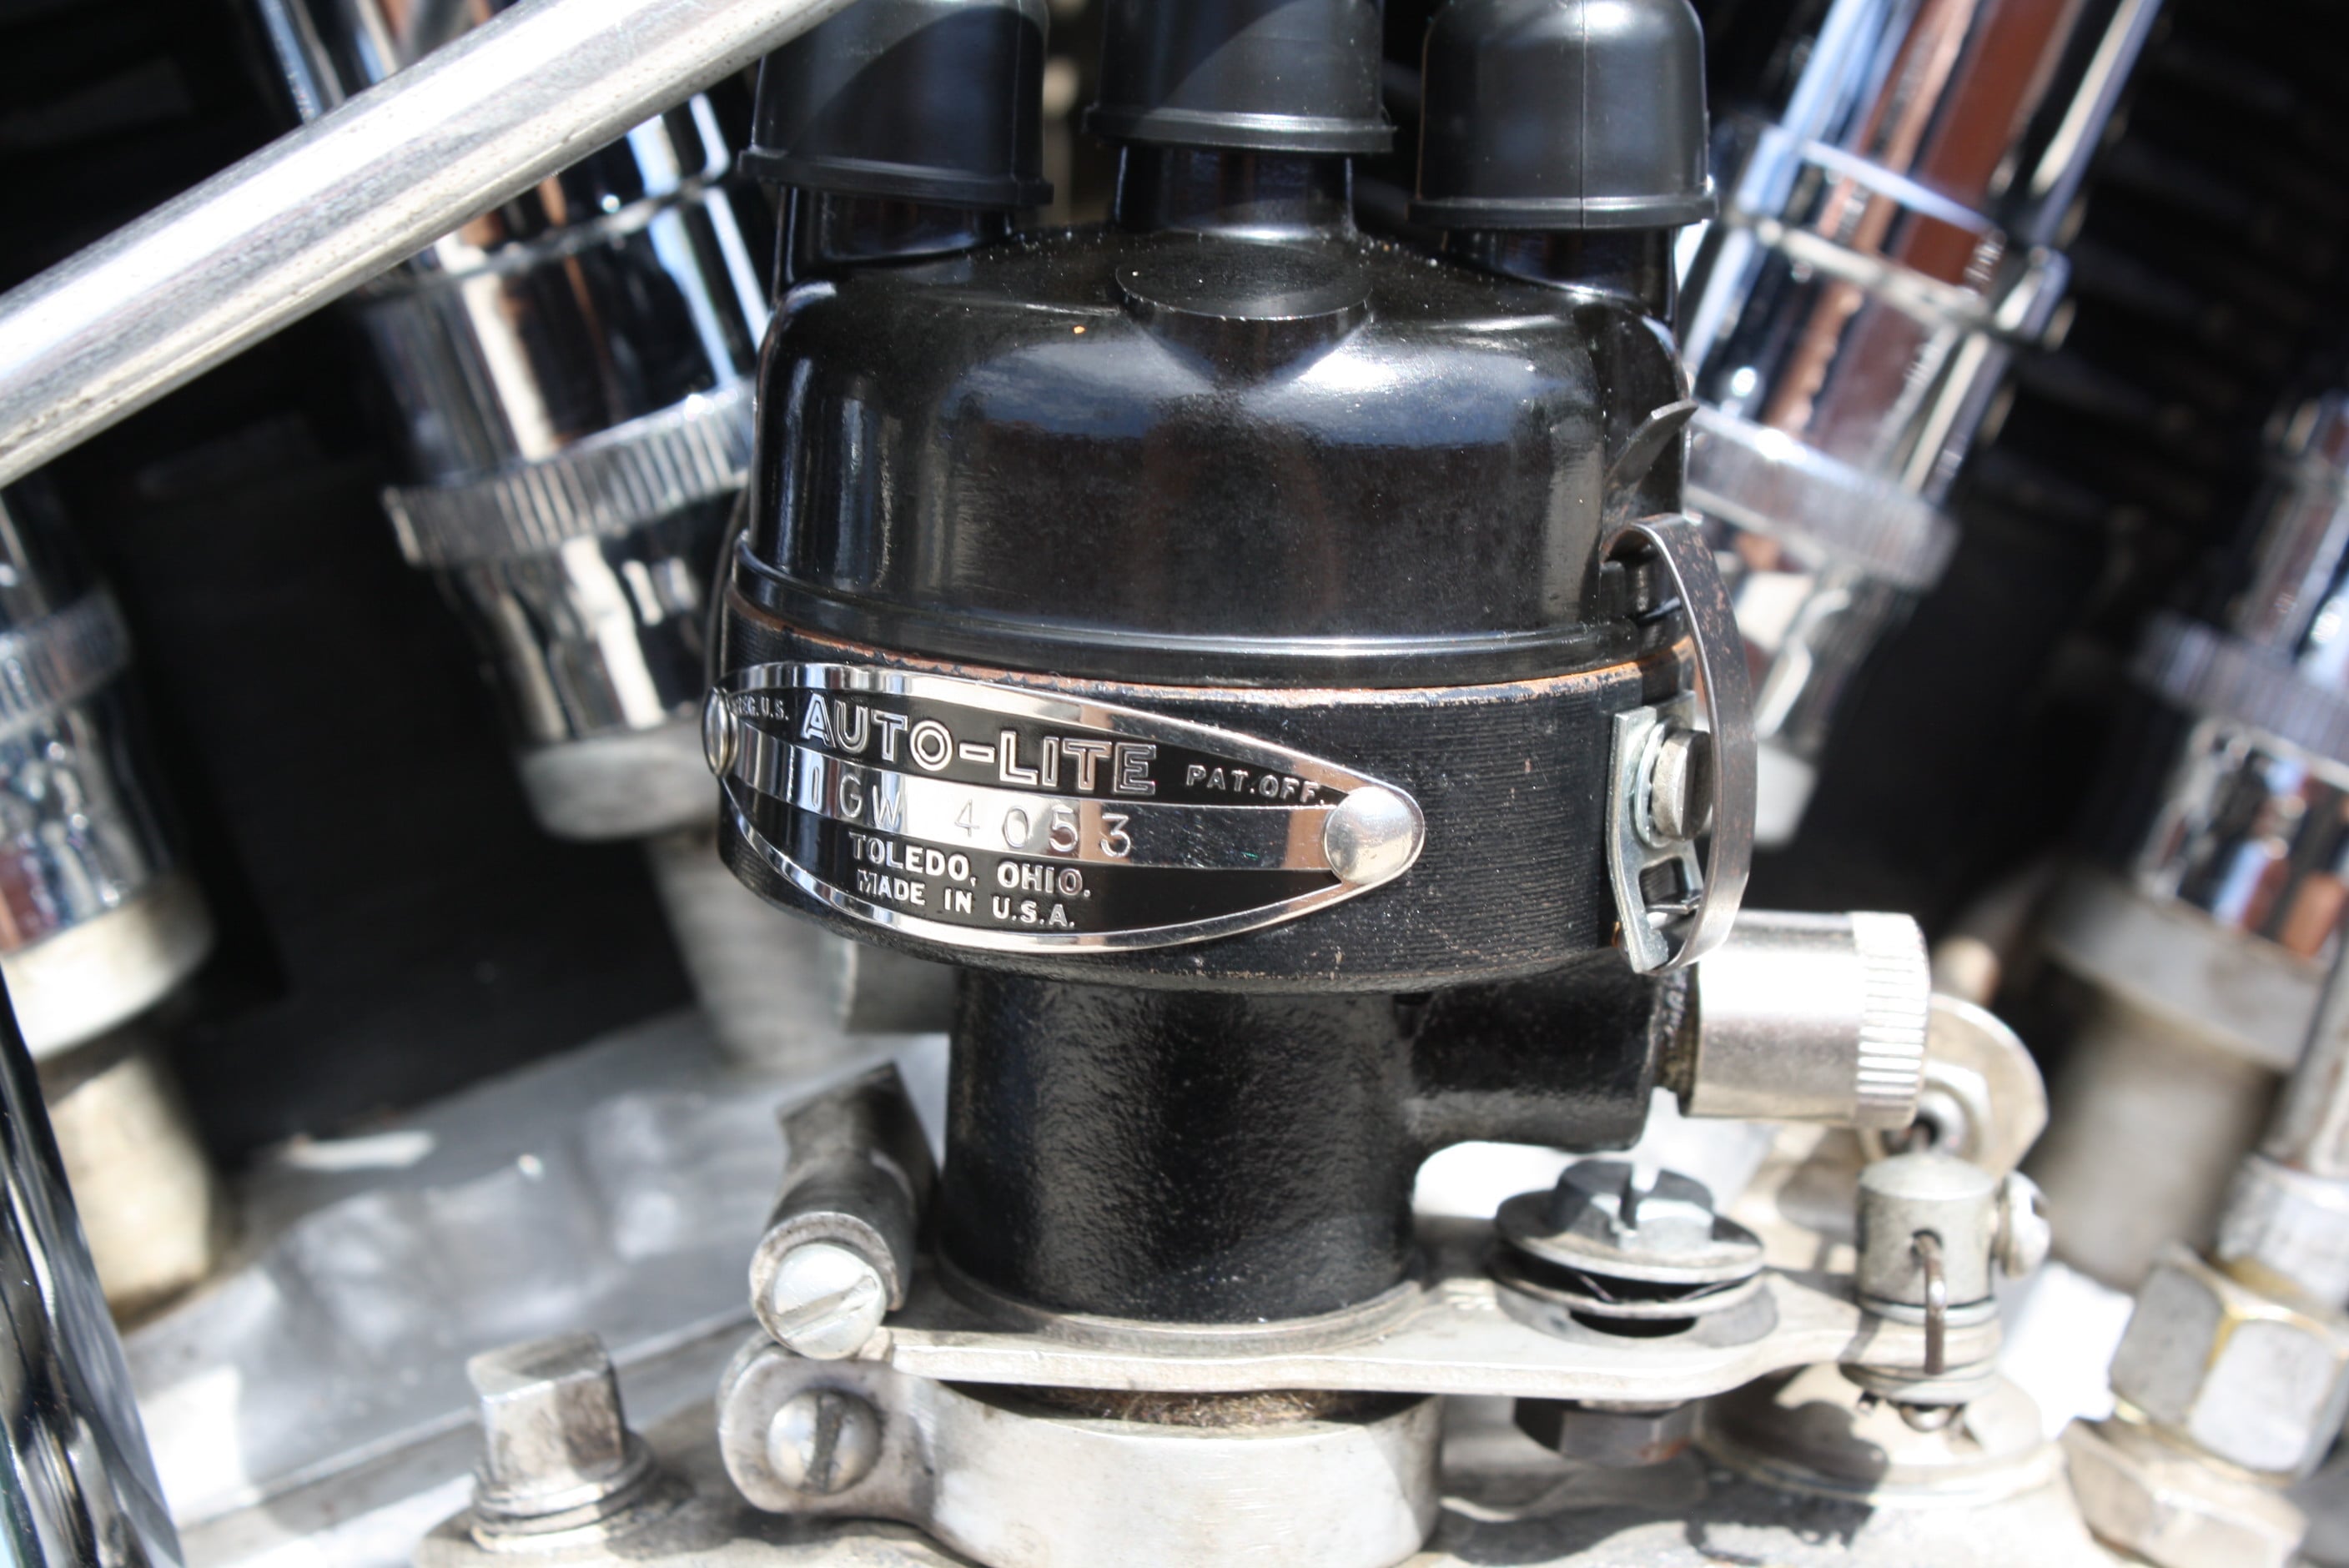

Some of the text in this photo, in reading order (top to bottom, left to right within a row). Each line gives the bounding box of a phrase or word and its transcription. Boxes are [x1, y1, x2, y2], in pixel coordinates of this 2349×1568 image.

[801, 691, 1156, 794] AUTO-LITE
[953, 798, 1132, 858] 4053
[848, 832, 1091, 897] TOLEDO, OHIO.
[856, 869, 1075, 928] MADE IN U.S.A.
